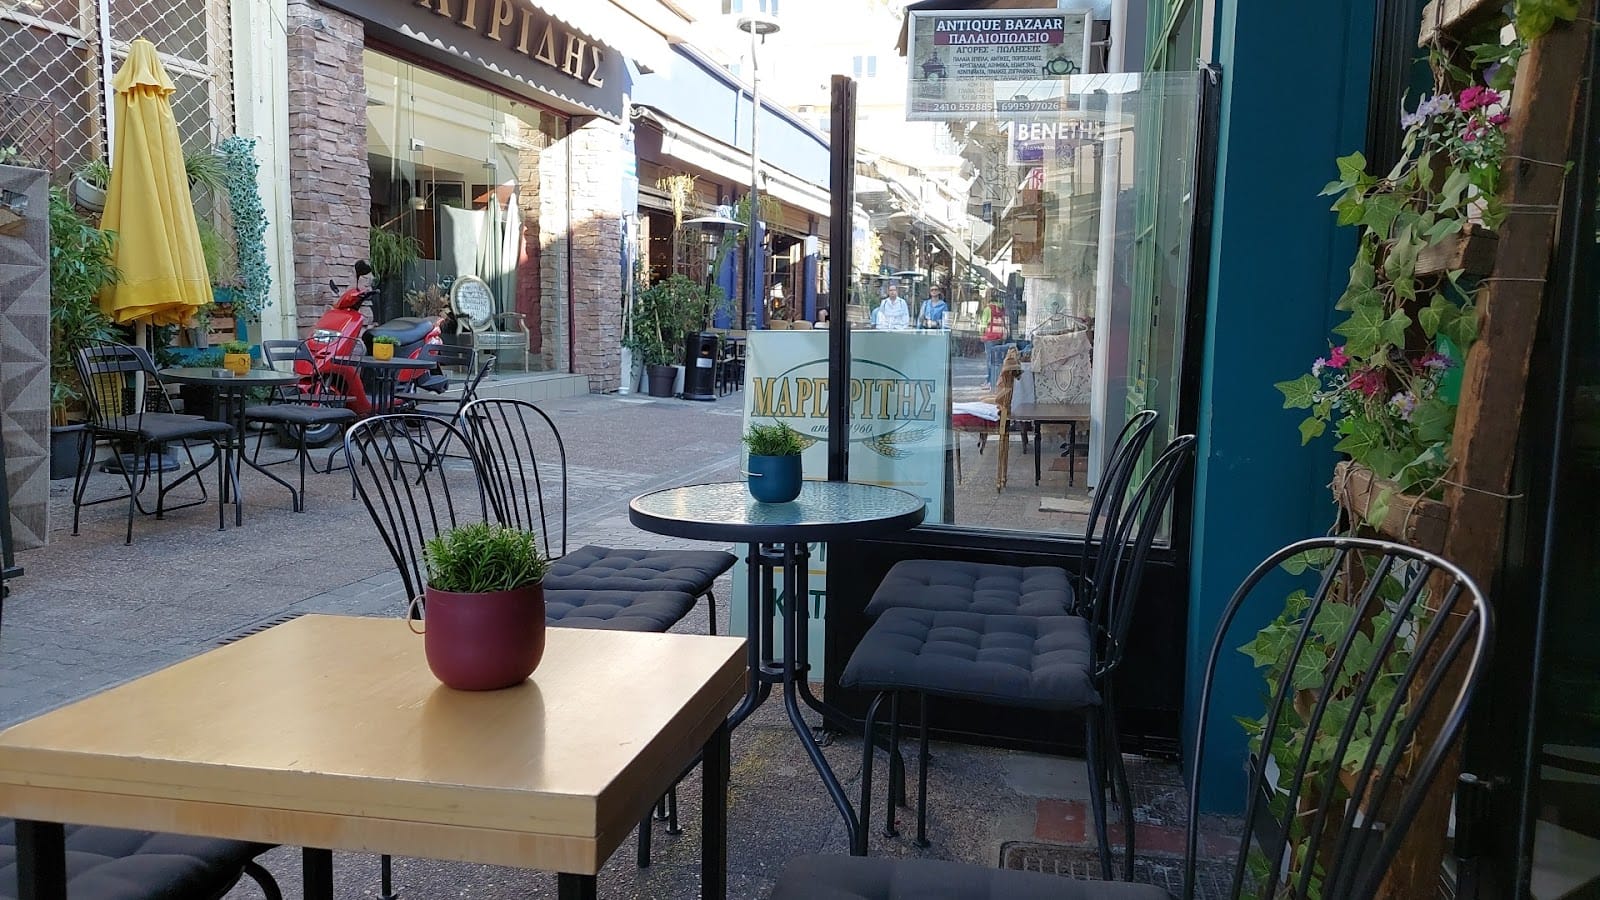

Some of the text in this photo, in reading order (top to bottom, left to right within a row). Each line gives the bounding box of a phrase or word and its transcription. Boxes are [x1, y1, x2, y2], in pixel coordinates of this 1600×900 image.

[936, 18, 1063, 32] ANTIQUE BAZAAR
[949, 32, 1049, 44] ΠΑΛΑΙΟΠΩΛΕΙΟ
[996, 45, 1041, 53] ΠΩΛΗΣΕΙΣ
[933, 103, 956, 111] 2410
[1001, 102, 1059, 111] 6995977026
[751, 377, 936, 421] ΜΑΡΓΡΙΤΗΣ
